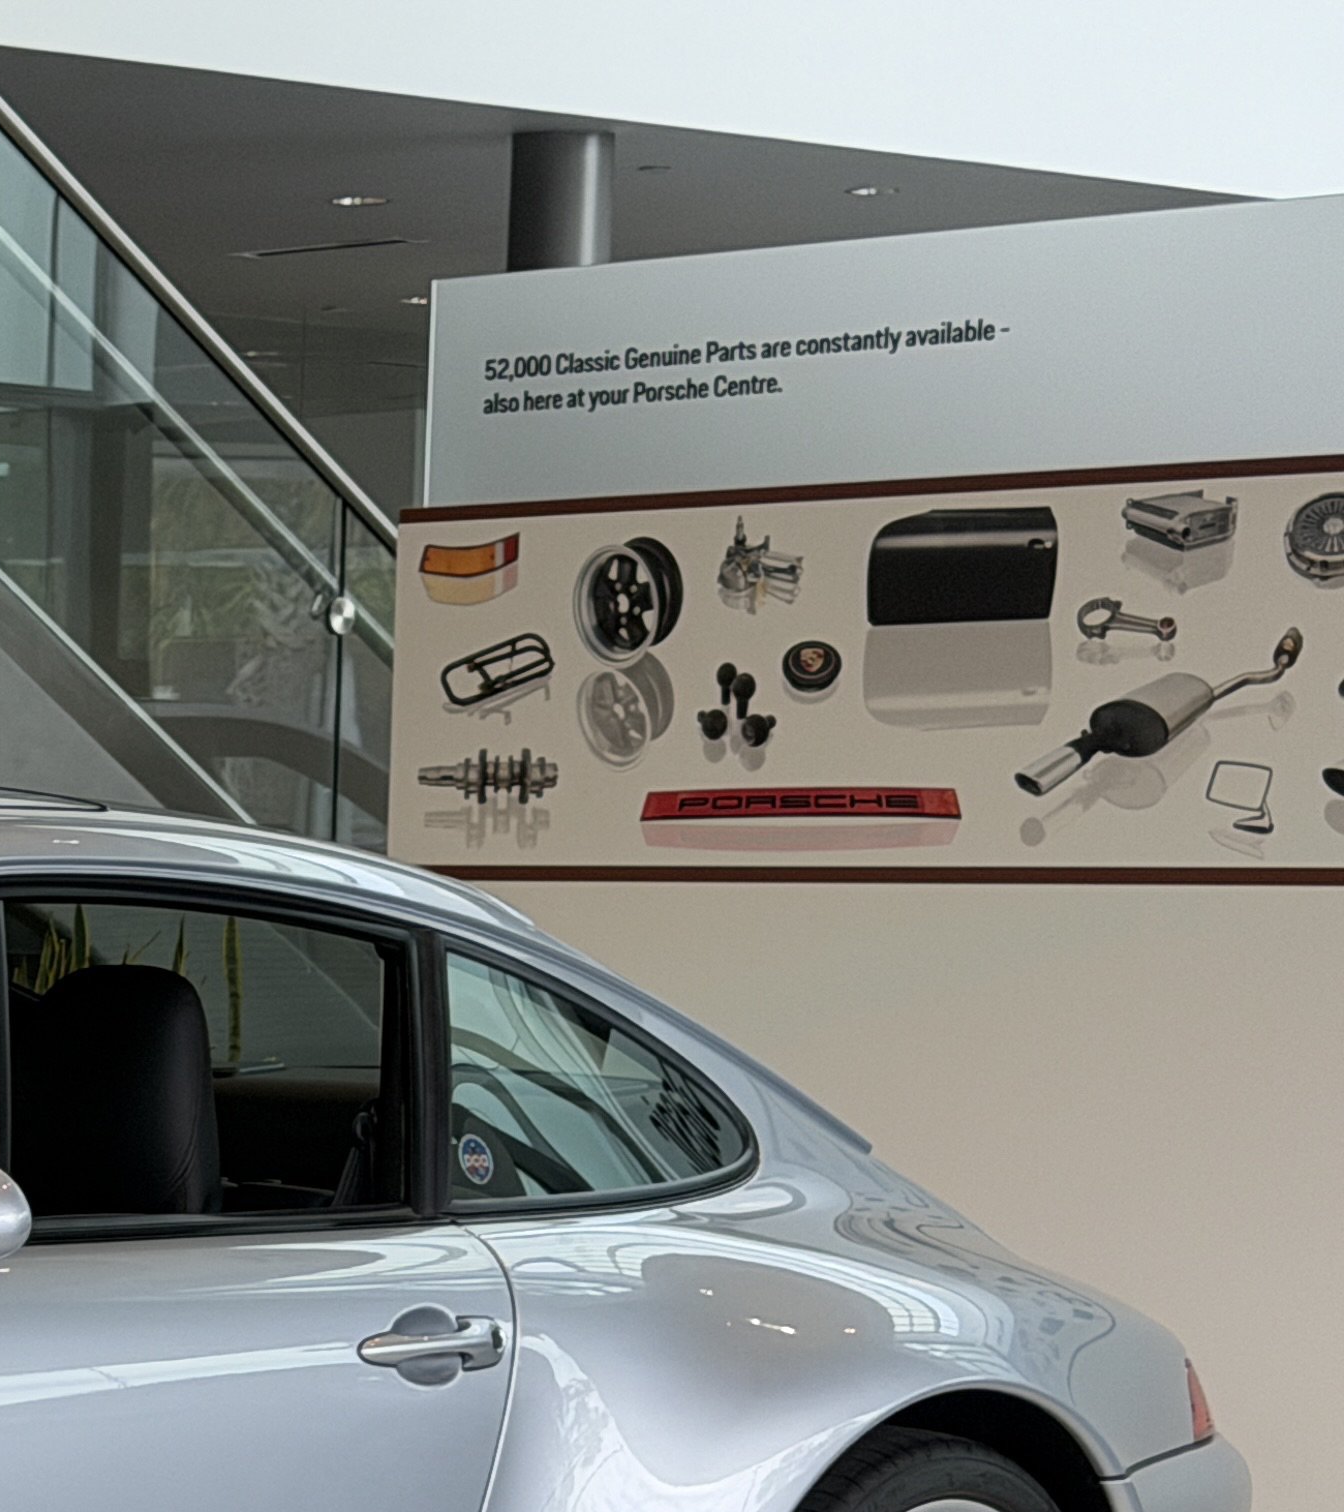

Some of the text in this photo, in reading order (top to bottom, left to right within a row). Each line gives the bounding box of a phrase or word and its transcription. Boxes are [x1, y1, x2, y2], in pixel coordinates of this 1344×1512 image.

[484, 354, 551, 382] 52,000
[556, 350, 620, 375] Classic
[625, 344, 701, 369] Genuine
[706, 340, 757, 364] Parts
[761, 341, 791, 359] are
[796, 327, 902, 355] constantly
[905, 319, 995, 347] available
[483, 374, 783, 414] also here at your Porsche Centre.
[678, 793, 920, 812] PORSCHE
